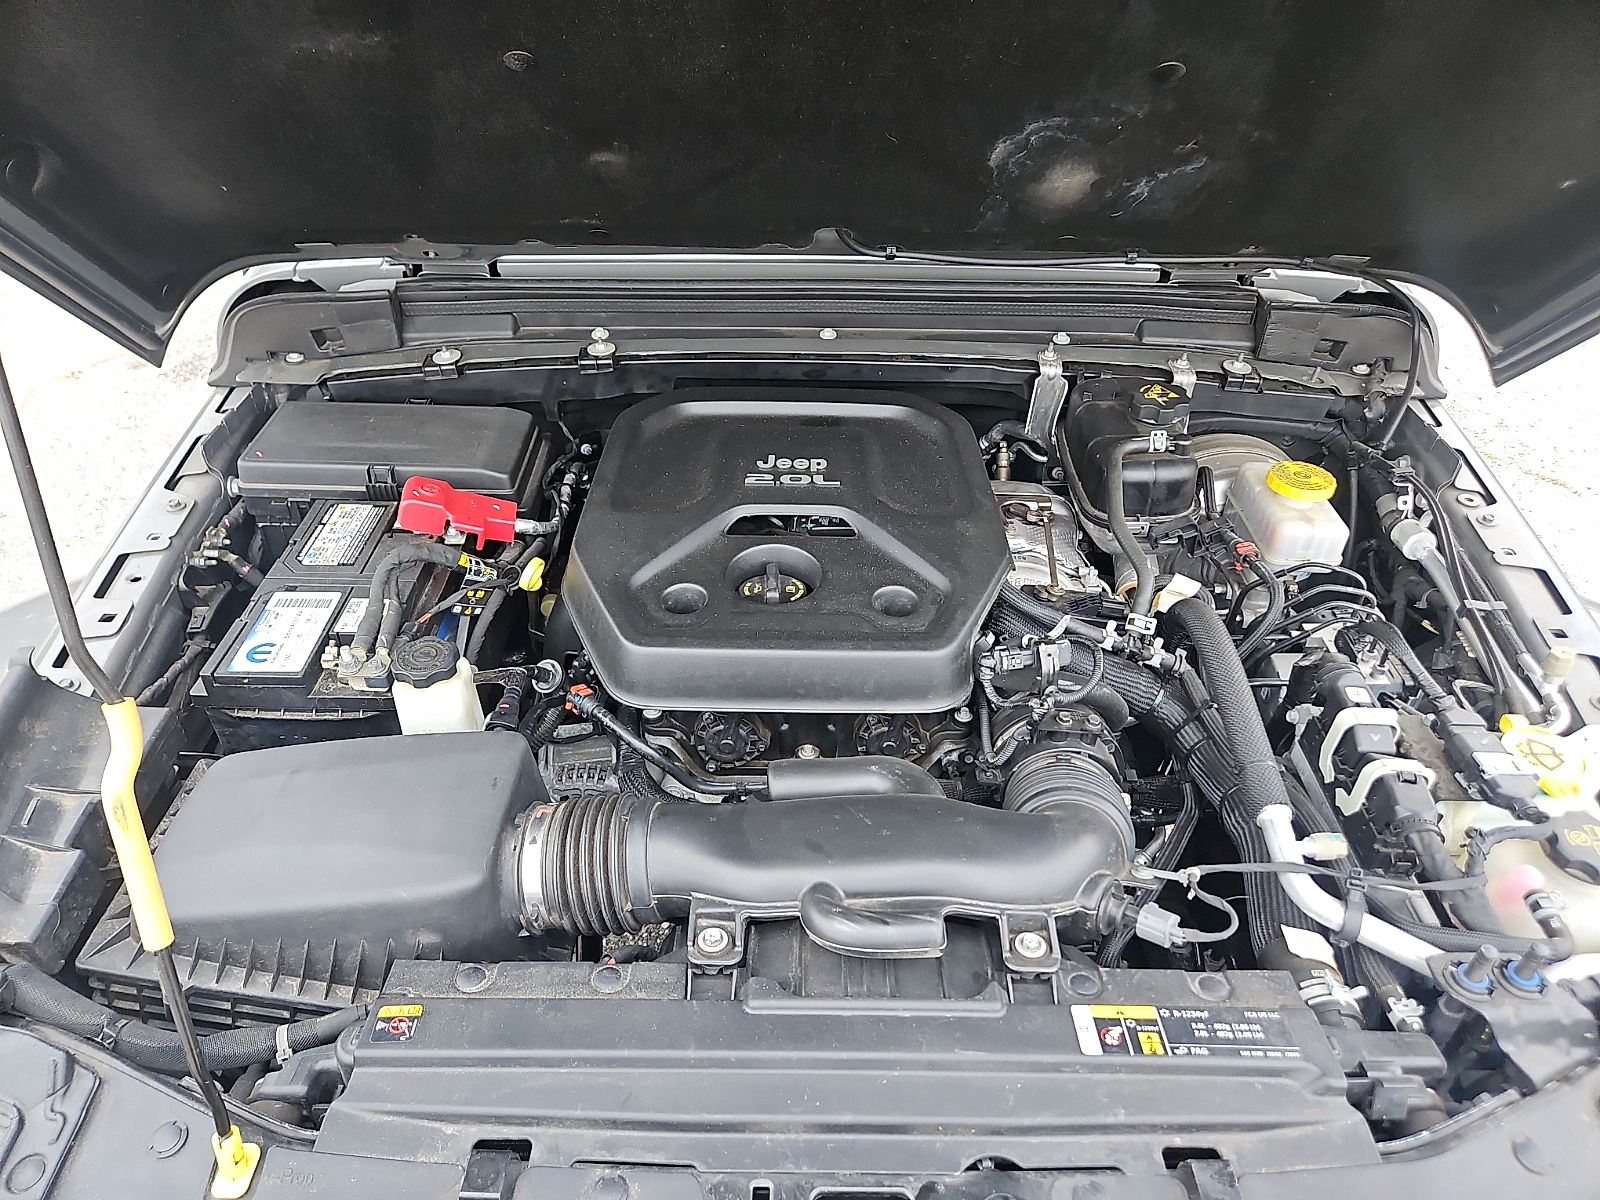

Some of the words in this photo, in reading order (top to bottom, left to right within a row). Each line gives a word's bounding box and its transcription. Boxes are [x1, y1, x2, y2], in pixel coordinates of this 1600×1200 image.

[756, 454, 828, 472] Jeep
[744, 474, 841, 487] 2.0L
[1190, 1046, 1209, 1055] PAG
